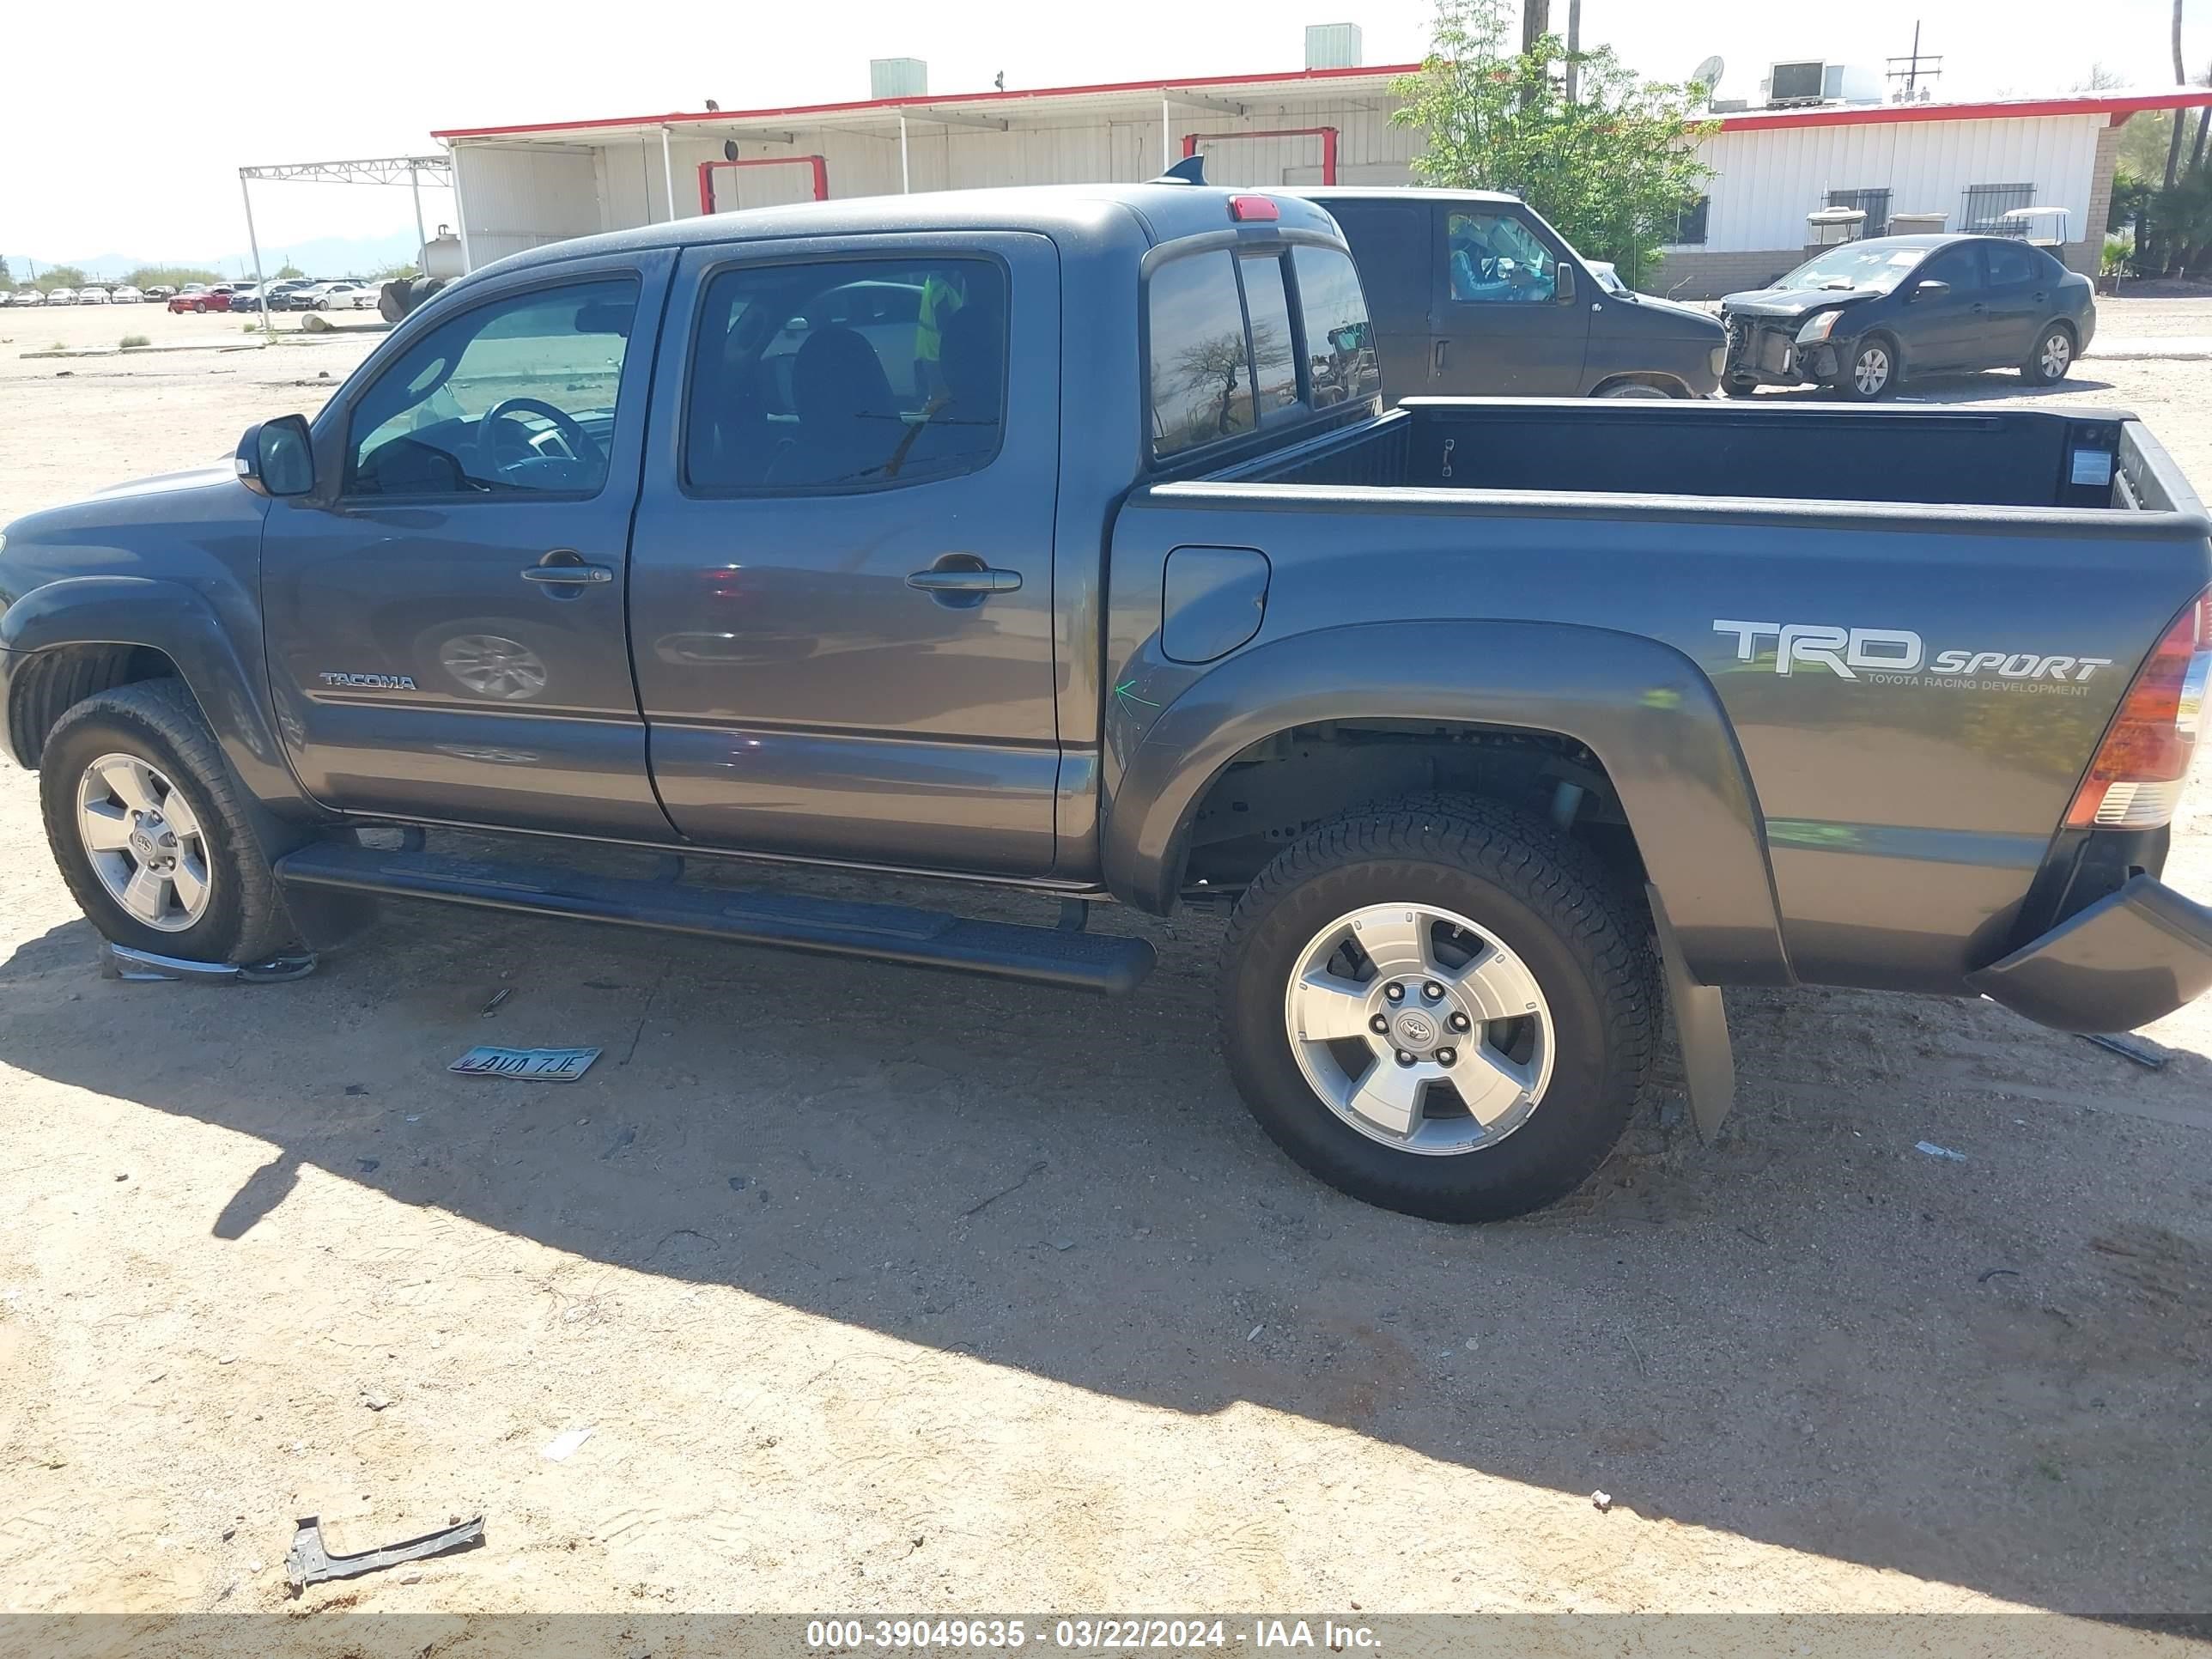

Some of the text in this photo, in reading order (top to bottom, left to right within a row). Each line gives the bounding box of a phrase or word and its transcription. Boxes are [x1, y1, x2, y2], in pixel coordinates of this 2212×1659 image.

[1712, 619, 2114, 683] TRD SPORT
[319, 672, 417, 690] TACOMA
[1868, 673, 2091, 696] TOYOTA RACING DEVELOPMENT
